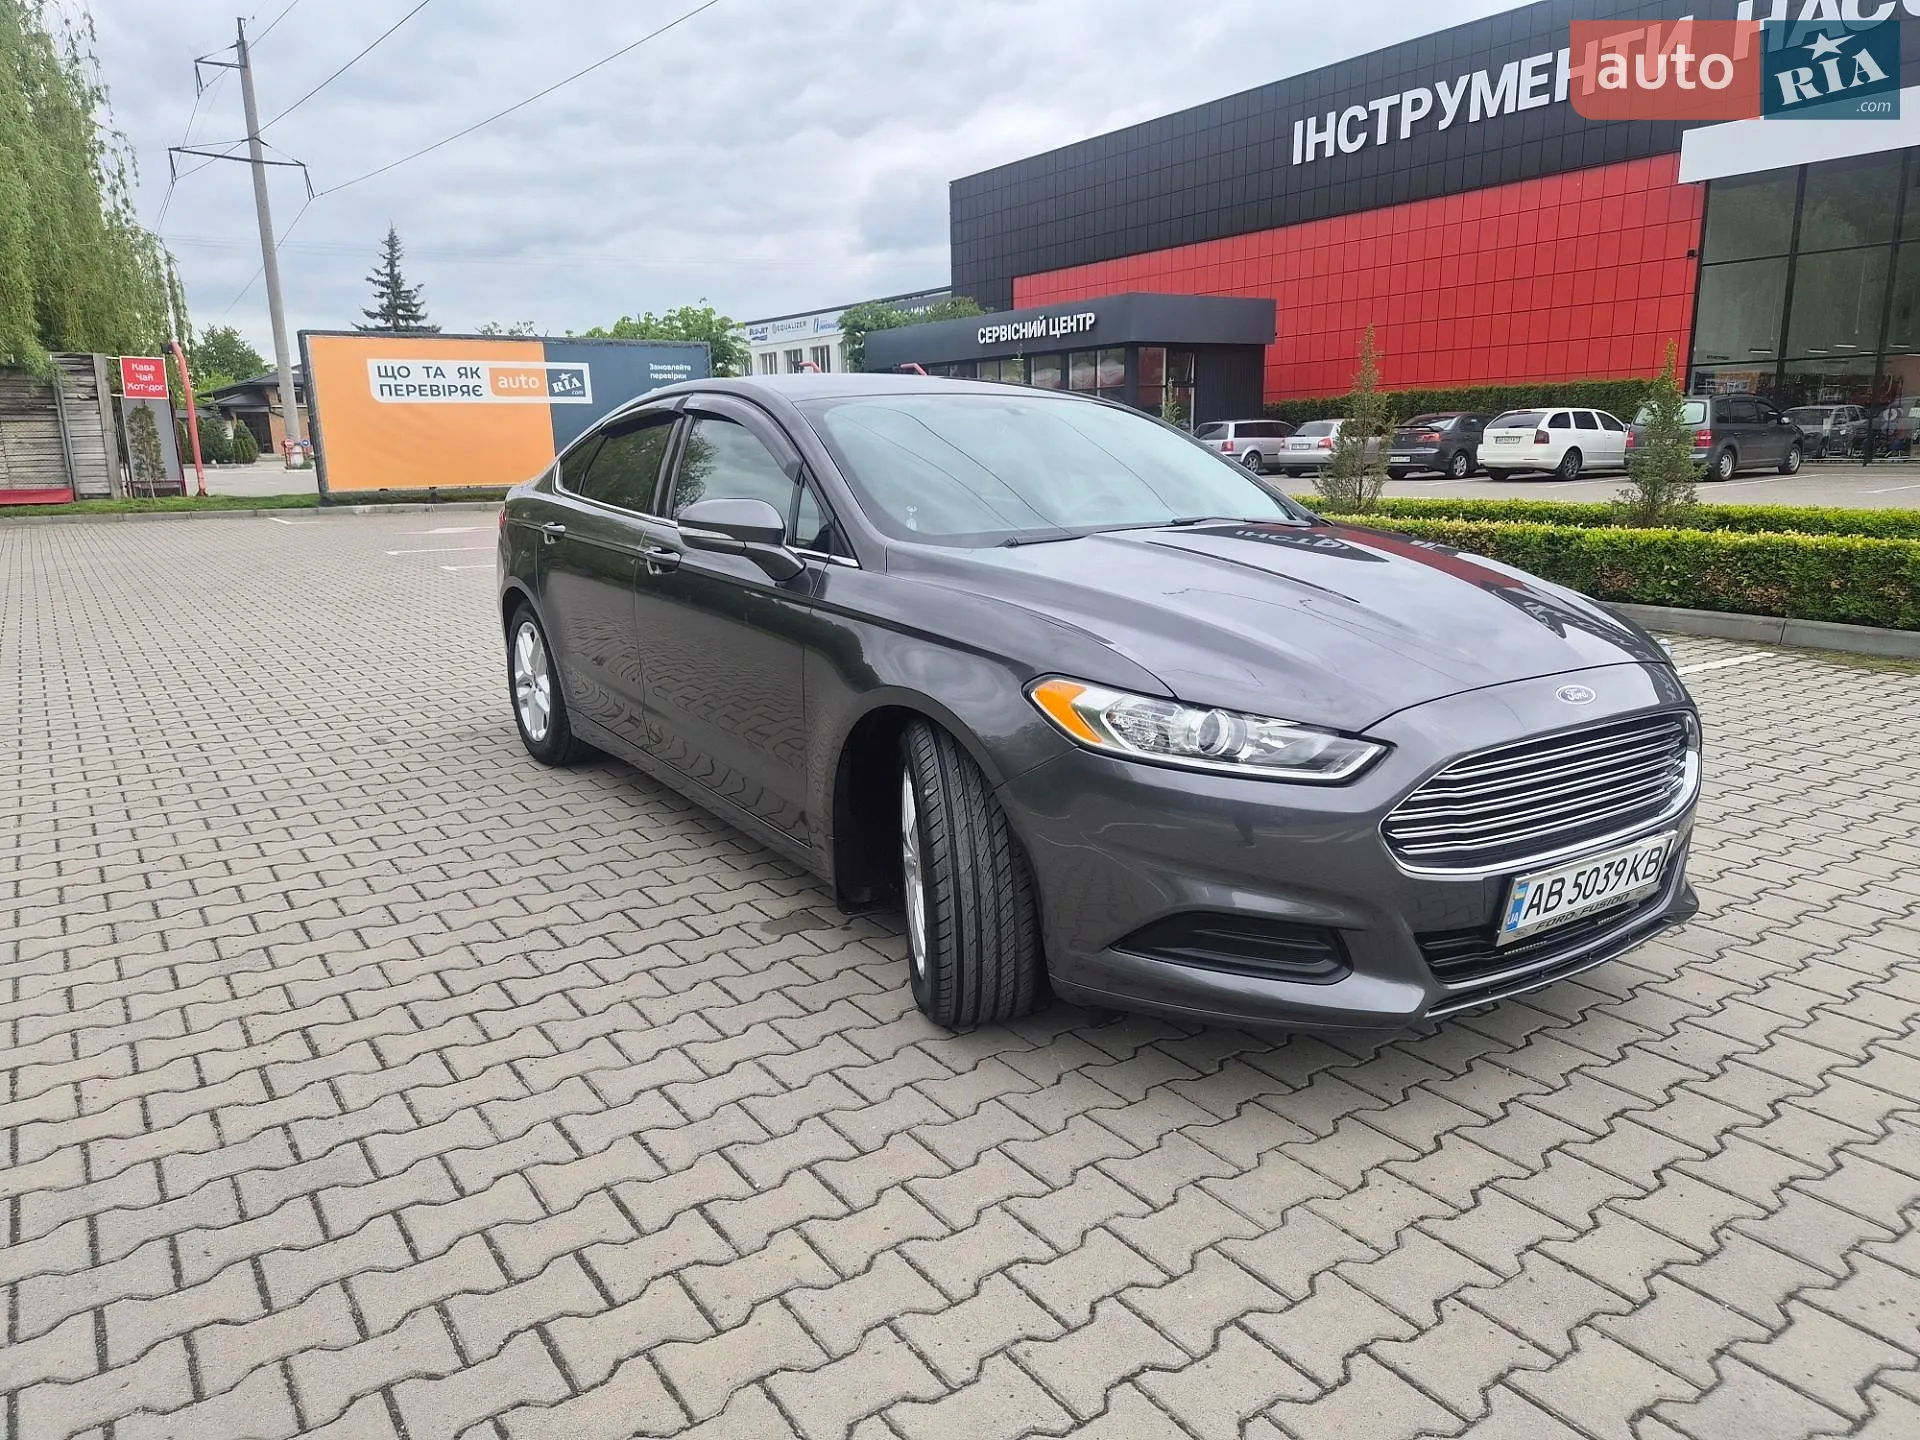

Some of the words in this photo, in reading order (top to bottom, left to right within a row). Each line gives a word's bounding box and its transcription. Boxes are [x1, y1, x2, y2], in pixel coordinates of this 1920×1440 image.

[1292, 15, 1694, 165] ІНСТРУМЕНТИ
[1733, 0, 1920, 60] НАС
[978, 315, 1046, 344] СЕРВІСНИЙ
[1049, 312, 1096, 338] ЦЕНТР
[131, 363, 155, 372] Кава
[377, 366, 411, 380] ЩО
[422, 366, 446, 379] ТА
[457, 366, 481, 379] ЯК
[135, 372, 154, 381] Чай
[498, 374, 540, 389] auto
[551, 377, 583, 393] RIA
[127, 382, 164, 392] Хот-дог
[379, 384, 483, 397] ПЕРЕВІРЯЄ
[1523, 877, 1565, 920] AB
[1568, 860, 1627, 904] 5039
[1625, 846, 1664, 886] KB
[1507, 912, 1520, 926] UA
[1535, 912, 1576, 930] FORD
